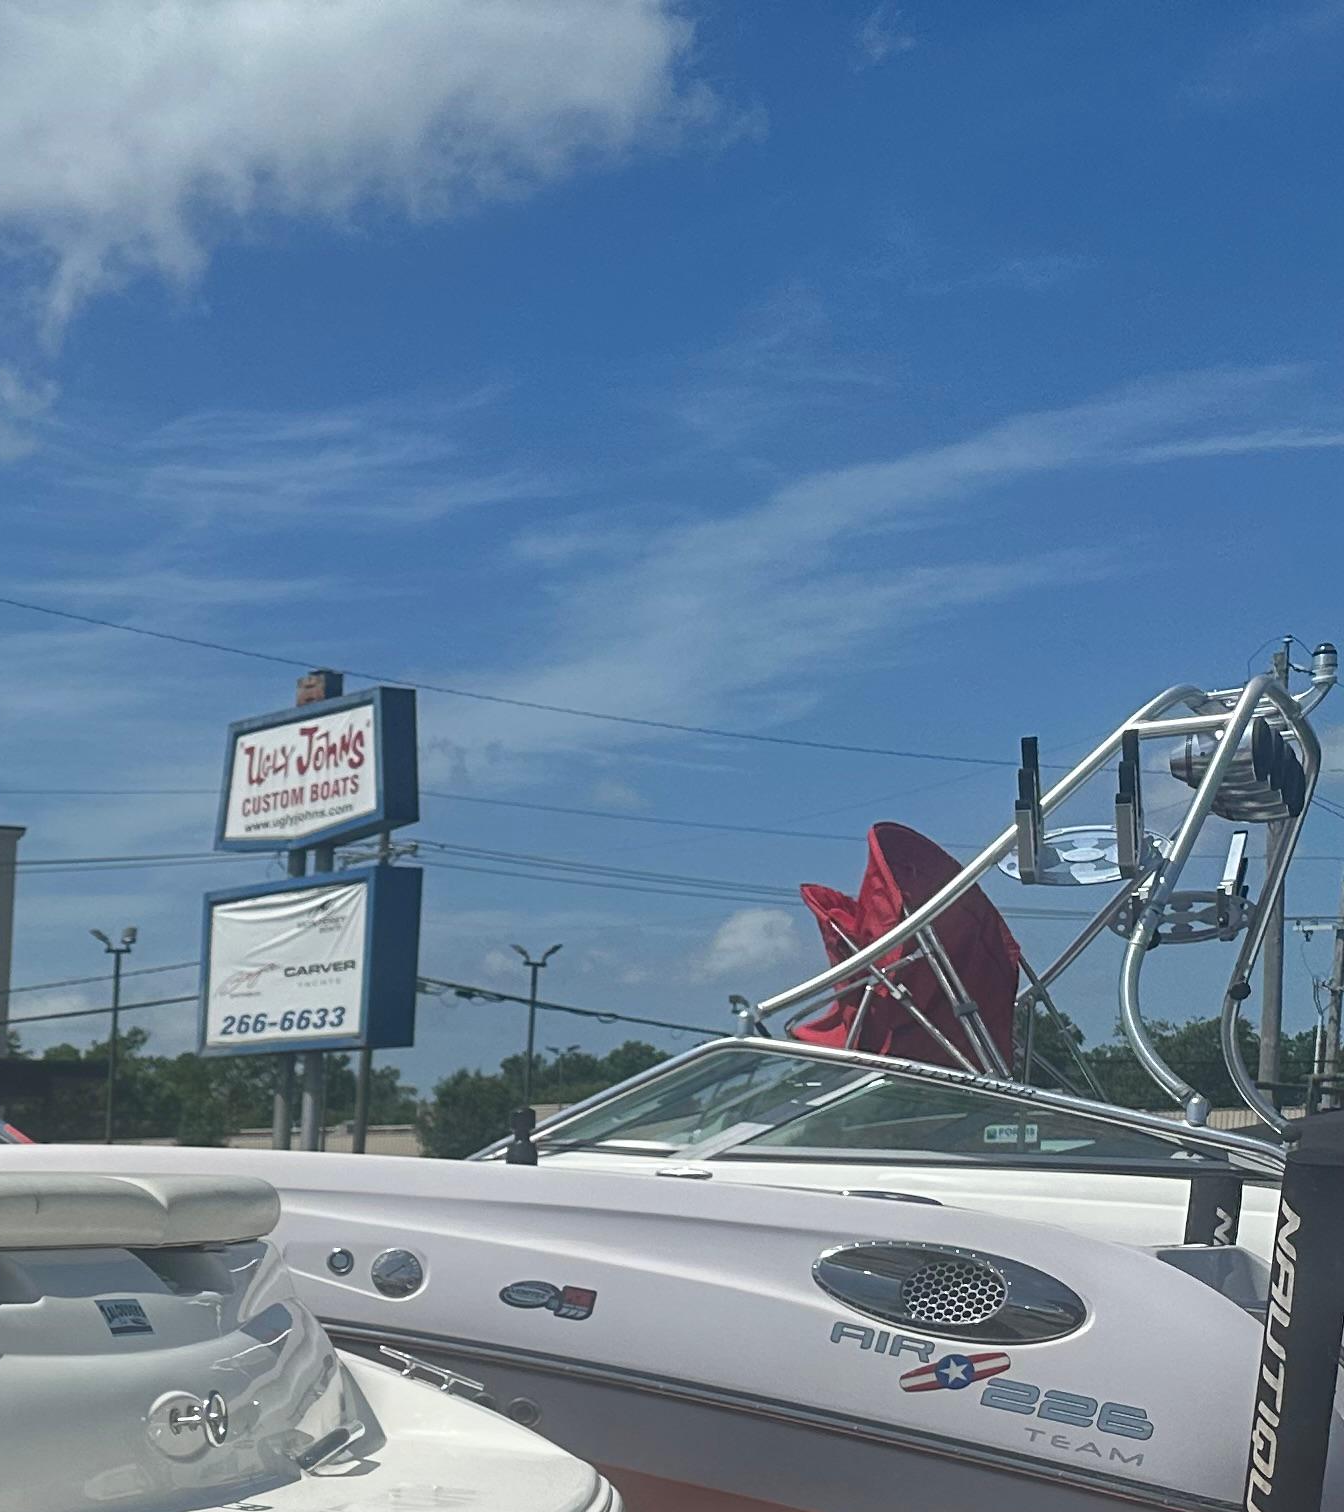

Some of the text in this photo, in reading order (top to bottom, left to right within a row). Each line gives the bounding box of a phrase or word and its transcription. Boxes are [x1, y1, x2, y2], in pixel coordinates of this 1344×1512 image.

[242, 774, 359, 817] CUSTOM BOATS
[284, 960, 356, 977] CARVER
[220, 1006, 346, 1036] 266-6633
[830, 1321, 936, 1363] AIR
[980, 1377, 1154, 1441] 226
[1025, 1427, 1145, 1467] TEAM
